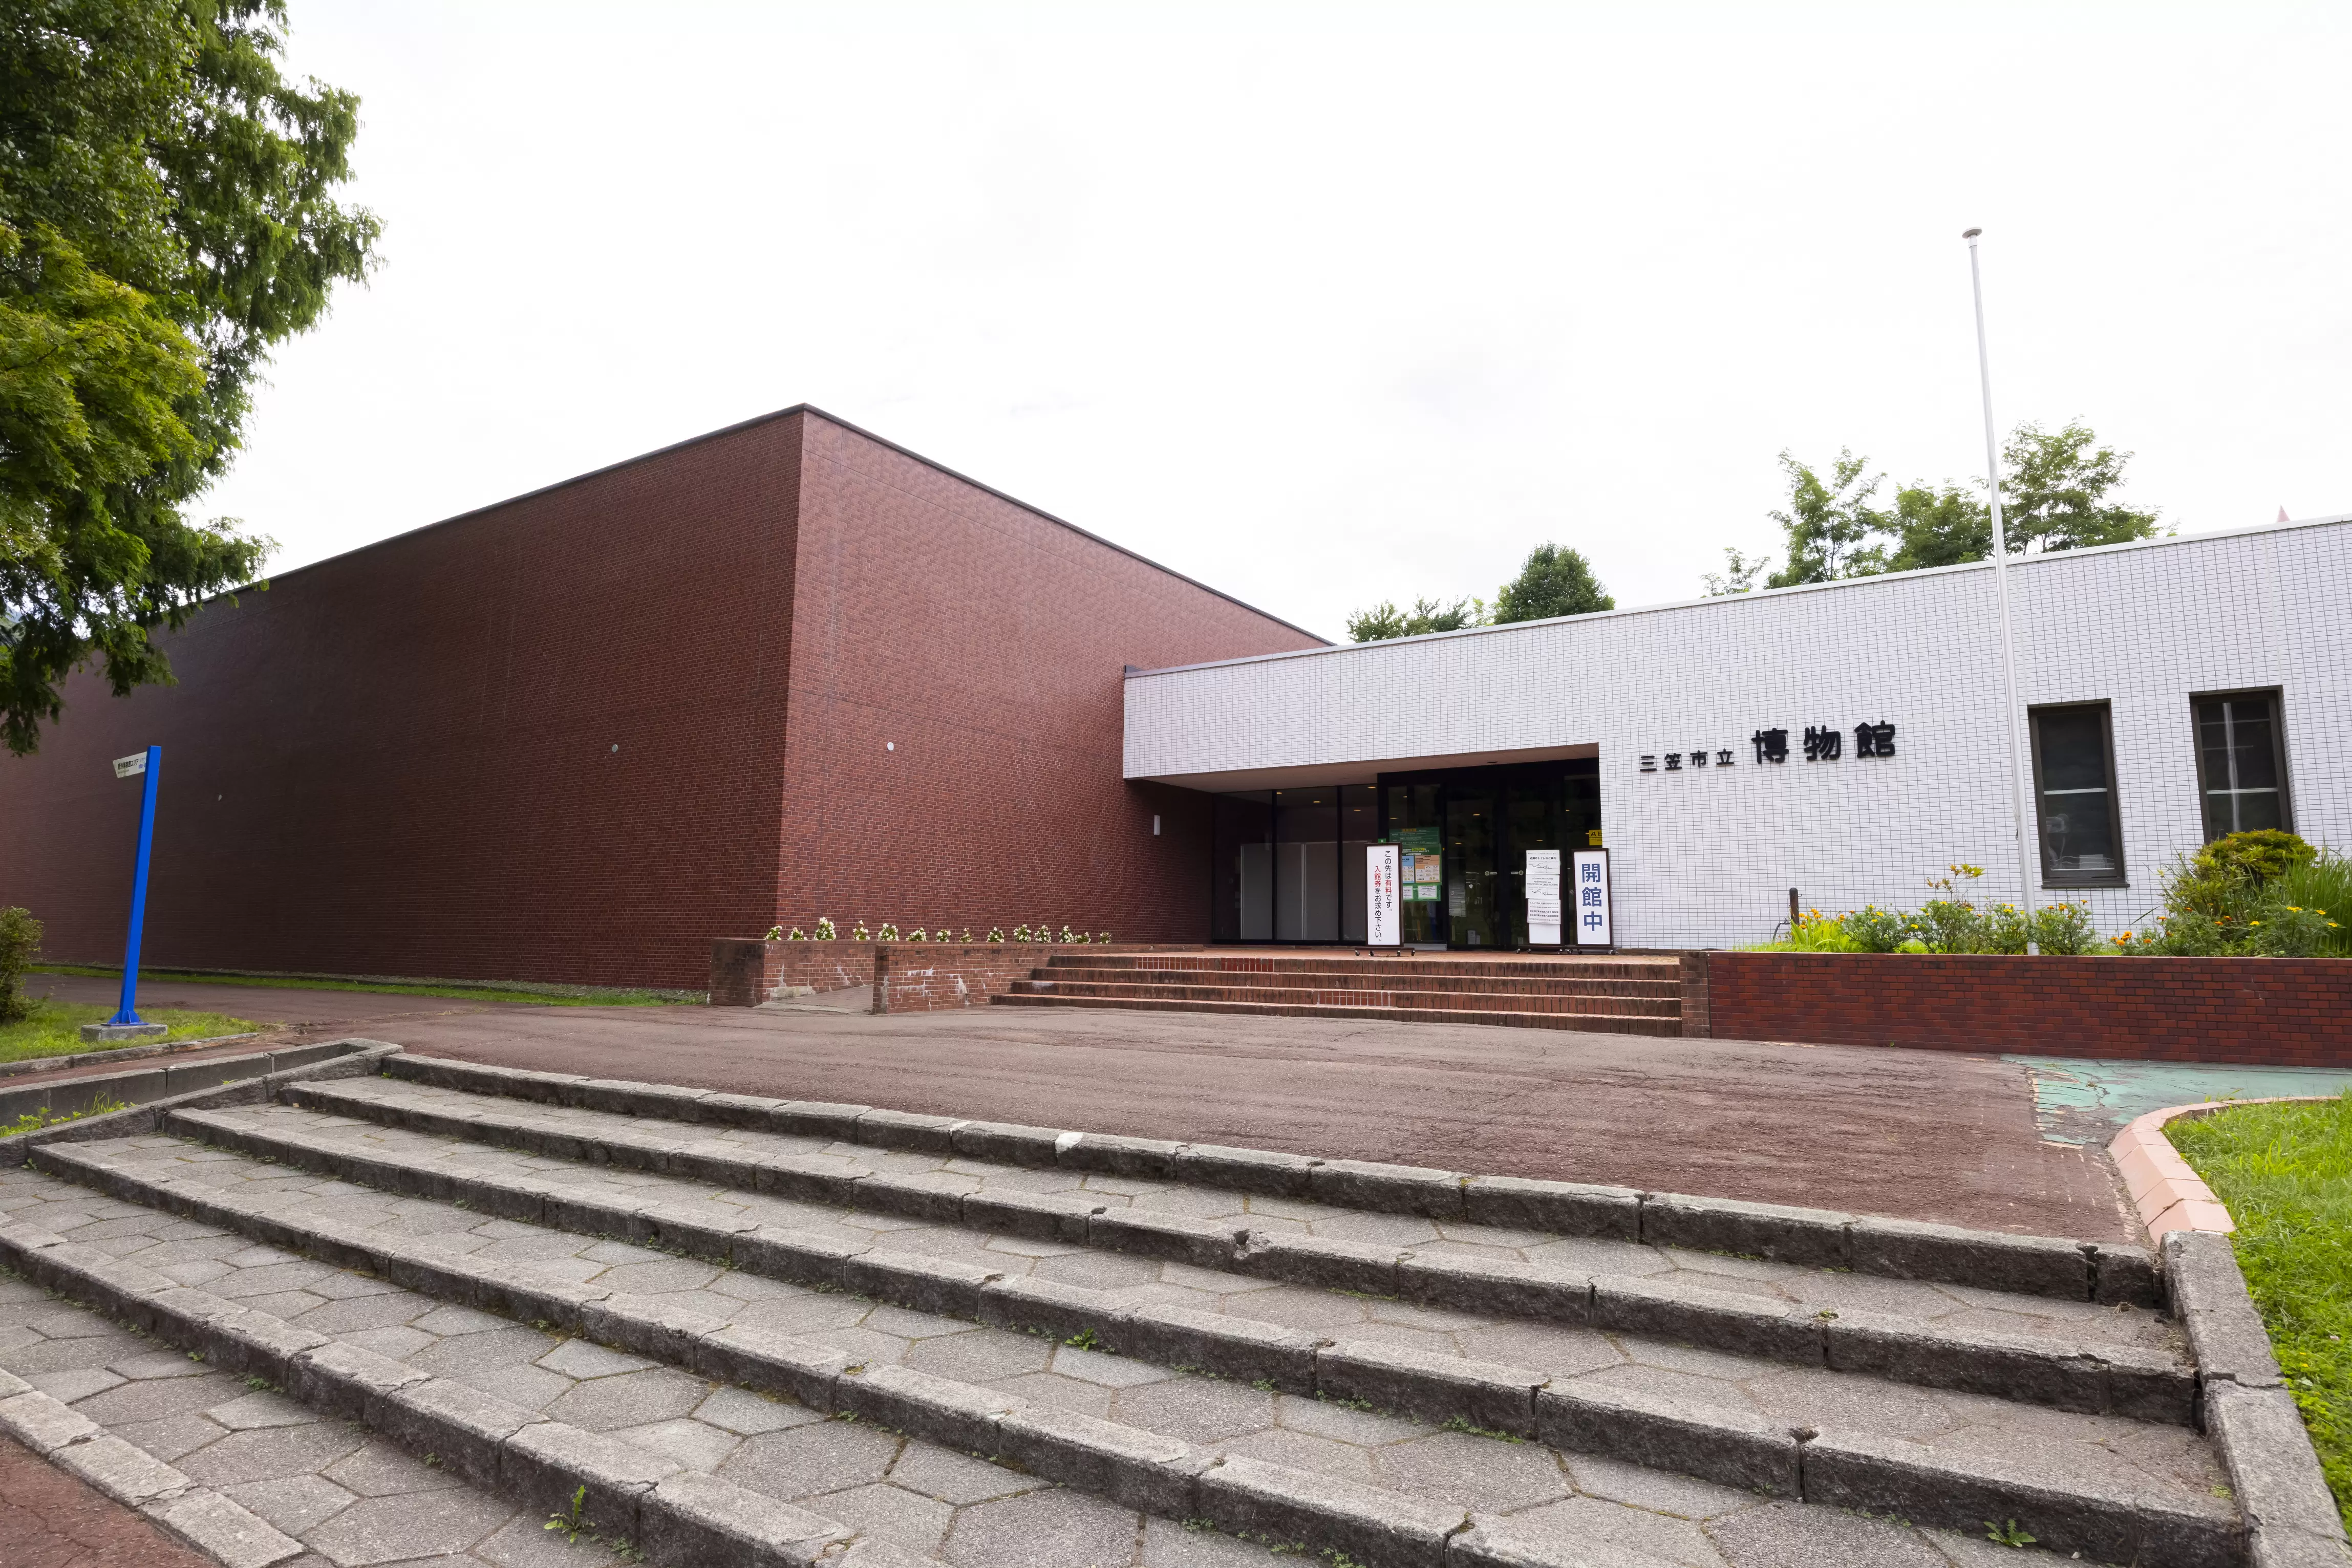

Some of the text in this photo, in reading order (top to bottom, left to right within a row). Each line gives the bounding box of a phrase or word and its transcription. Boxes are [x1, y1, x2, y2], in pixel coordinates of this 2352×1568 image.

[1639, 720, 1896, 772] 三笠市立博物館
[1581, 863, 1602, 931] 開館中
